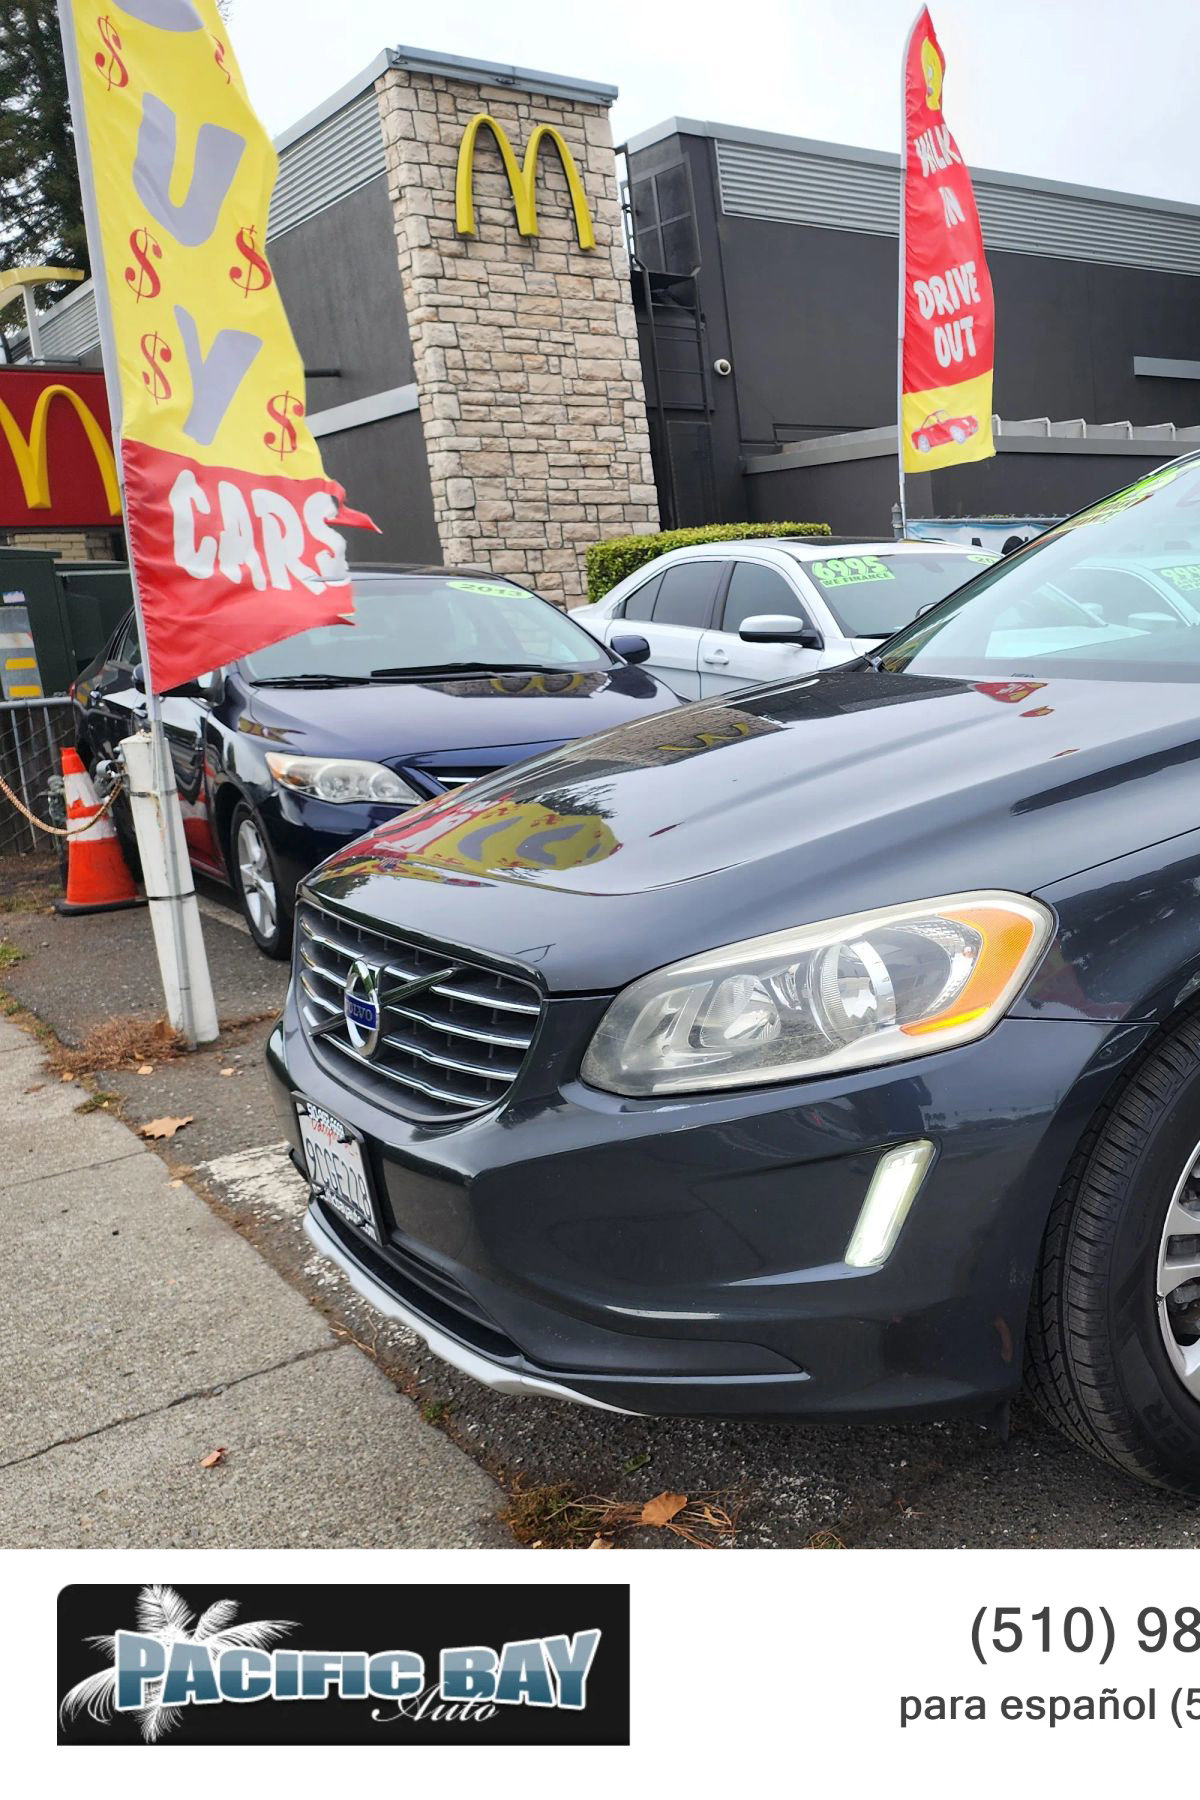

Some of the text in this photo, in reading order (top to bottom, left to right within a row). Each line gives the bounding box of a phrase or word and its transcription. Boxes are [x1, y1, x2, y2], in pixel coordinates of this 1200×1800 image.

[456, 112, 596, 251] M
[913, 260, 981, 321] DRIVE
[933, 315, 977, 368] OUT
[168, 469, 352, 595] CARS
[812, 556, 889, 580] 6995
[822, 571, 890, 587] WE FINANCE
